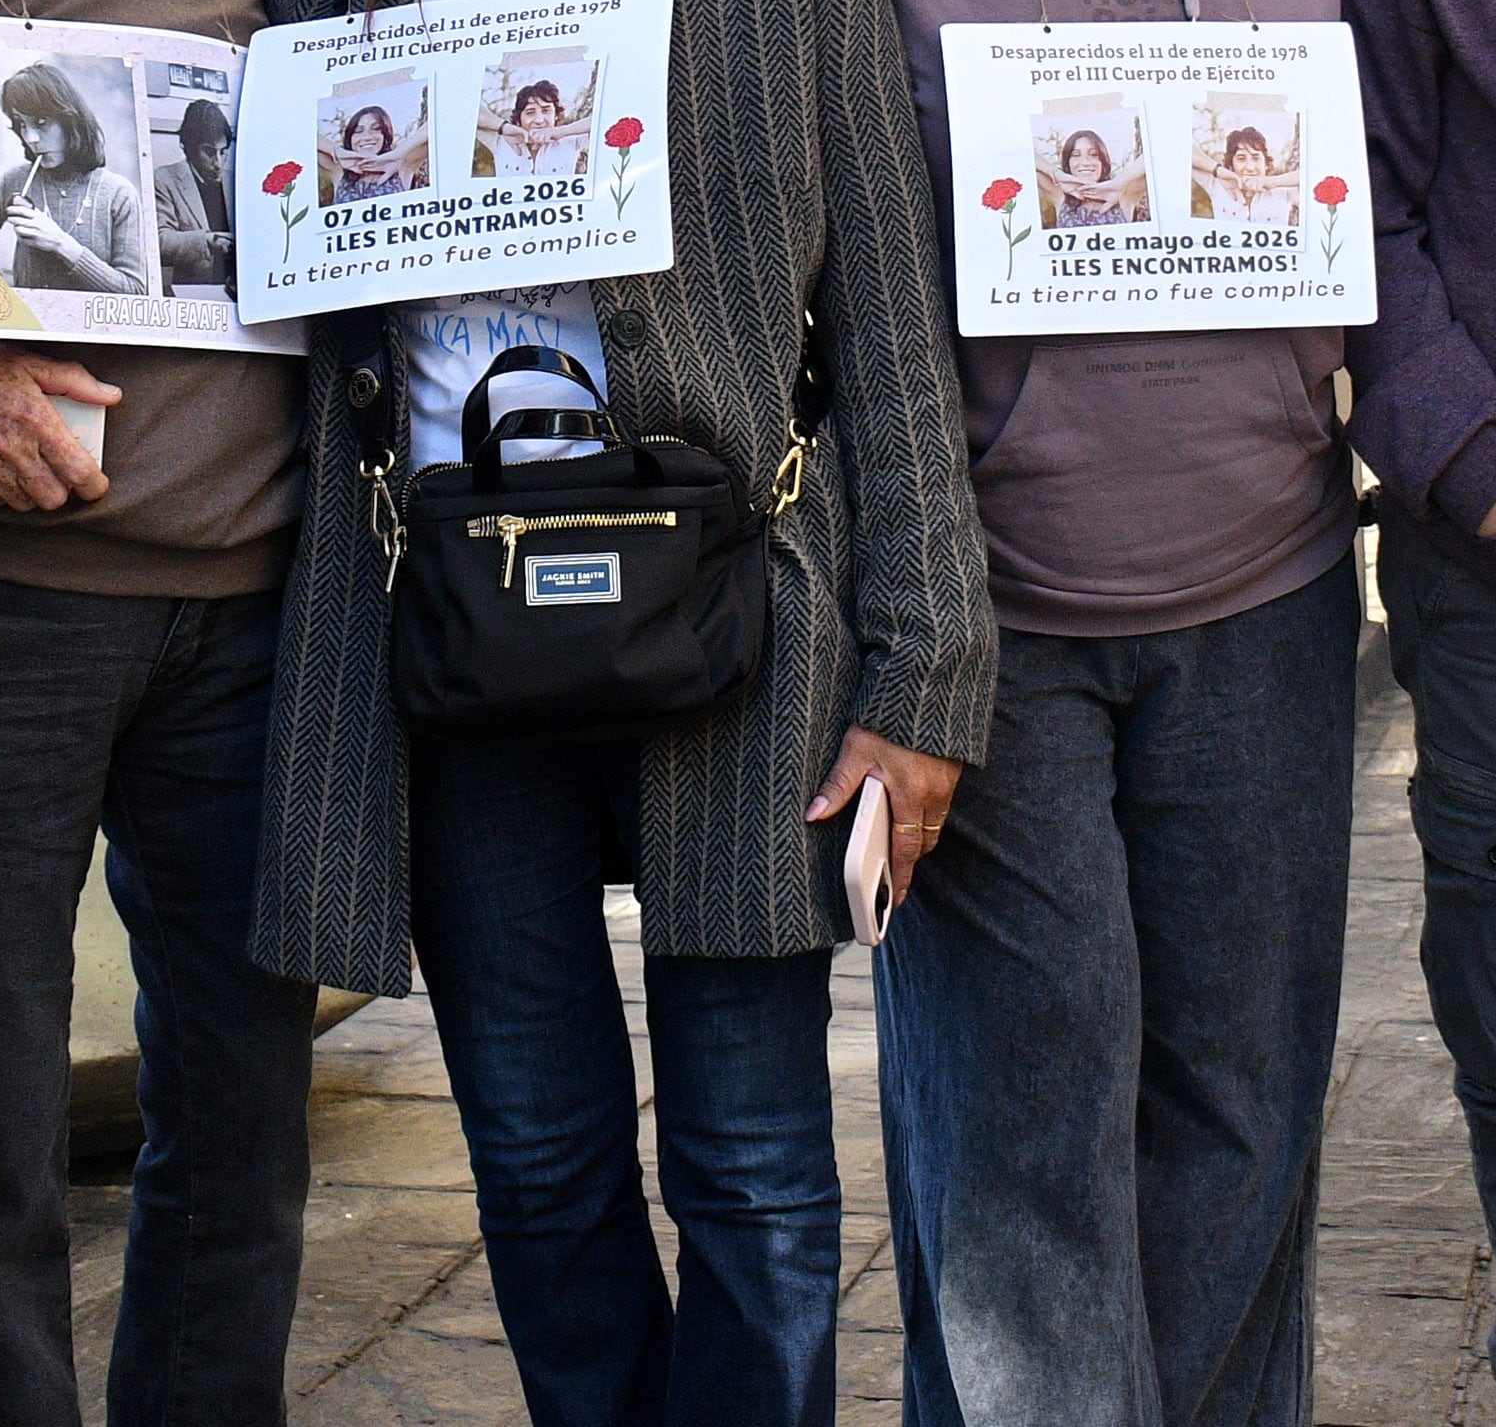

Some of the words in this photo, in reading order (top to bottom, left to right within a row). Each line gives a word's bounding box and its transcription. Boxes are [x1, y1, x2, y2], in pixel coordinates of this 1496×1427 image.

[292, 24, 425, 53] Desaparecidos
[429, 18, 445, 33] el
[450, 19, 465, 30] 11
[470, 13, 491, 28] de
[496, 8, 549, 23] enero
[554, 2, 576, 17] de
[325, 53, 357, 71] por
[361, 47, 377, 63] el
[381, 44, 404, 60] III
[408, 37, 475, 56] Cuerpo
[479, 31, 501, 46] de
[506, 22, 580, 44] Ejército
[990, 43, 1124, 63] Desaparecidos
[1129, 43, 1144, 59] el
[1149, 47, 1164, 59] 11
[1168, 43, 1188, 59] de
[1193, 47, 1242, 59] enero
[1247, 43, 1266, 59] de
[1271, 45, 1308, 61] 1978
[1031, 69, 1061, 85] por
[1066, 66, 1082, 81] el
[1086, 67, 1108, 81] III
[1112, 66, 1177, 85] Cuerpo
[1181, 65, 1201, 81] de
[1206, 65, 1275, 84] Ejército
[323, 209, 353, 229] 07
[362, 204, 392, 223] de
[402, 196, 472, 218] mayo
[482, 188, 513, 207] de
[523, 178, 585, 202] 2026
[326, 230, 376, 254] ¡LES
[387, 204, 584, 245] ENCONTRAMOS!
[1048, 234, 1077, 252] 07
[1086, 232, 1115, 251] de
[1126, 235, 1194, 255] mayo
[1203, 230, 1232, 249] de
[1241, 229, 1298, 248] 2026
[267, 271, 296, 289] La
[307, 258, 390, 283] tierra
[401, 253, 433, 270] no
[445, 245, 491, 263] fue
[504, 228, 637, 255] cómplice
[1051, 259, 1102, 277] ¡LES
[1112, 255, 1298, 276] ENCONTRAMOS!
[990, 287, 1021, 304] La
[1032, 285, 1116, 303] tierra
[1127, 287, 1159, 301] no
[1169, 283, 1213, 300] fue
[1224, 280, 1345, 302] cómplice
[84, 296, 170, 329] ¡GRACIAS
[175, 301, 229, 332] EAAF!
[418, 313, 471, 356] NCA
[541, 573, 575, 582] JACKIE
[577, 571, 605, 580] SMITH
